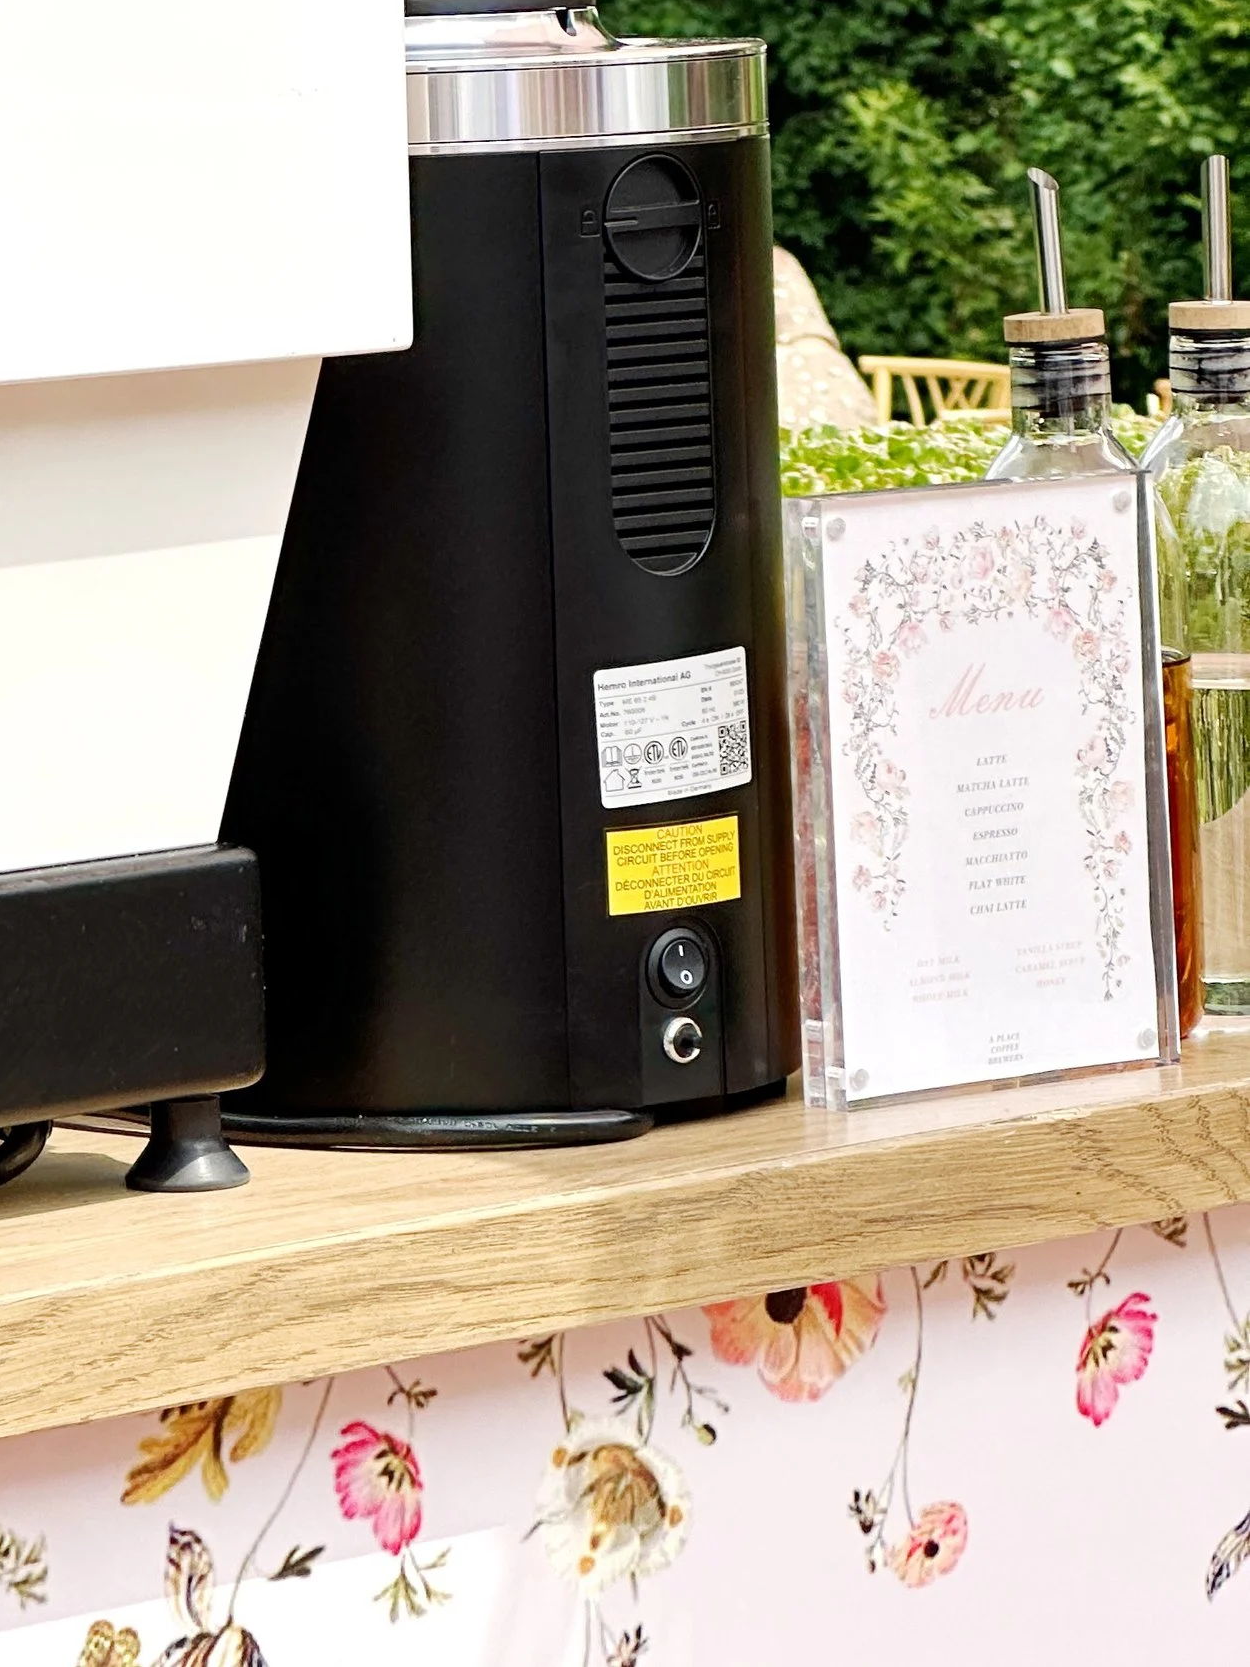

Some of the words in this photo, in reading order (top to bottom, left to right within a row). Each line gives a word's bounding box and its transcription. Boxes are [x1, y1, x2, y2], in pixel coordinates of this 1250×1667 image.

[628, 673, 679, 689] International
[680, 671, 692, 680] AG
[928, 662, 1045, 720] Menu
[976, 754, 1008, 766] LATTE
[956, 780, 996, 793] MATCHA
[999, 776, 1030, 788] LATTE
[964, 802, 1024, 817] CAPPUCCINO
[657, 824, 703, 840] CAUTION
[973, 827, 1018, 841] ESPRESSO
[613, 839, 677, 856] DISCONNECT
[680, 836, 705, 849] FROM
[707, 831, 736, 845] SUPPLY
[617, 853, 657, 867] CIRCUIT
[660, 850, 696, 863] BEFORE
[699, 843, 734, 857] OPENING
[652, 859, 709, 876] ATTENTION
[615, 874, 690, 892] DÉCONNECTER
[693, 872, 704, 882] DU
[706, 866, 736, 880] CIRCUIT
[968, 878, 993, 891] FLAT
[995, 875, 1027, 887] WHITE
[644, 882, 717, 900] D'ALIMENTATION
[644, 898, 674, 910] AVANT
[677, 892, 718, 906] D'OUVRIR
[969, 902, 994, 915] CHAI
[996, 899, 1027, 912] LATTE
